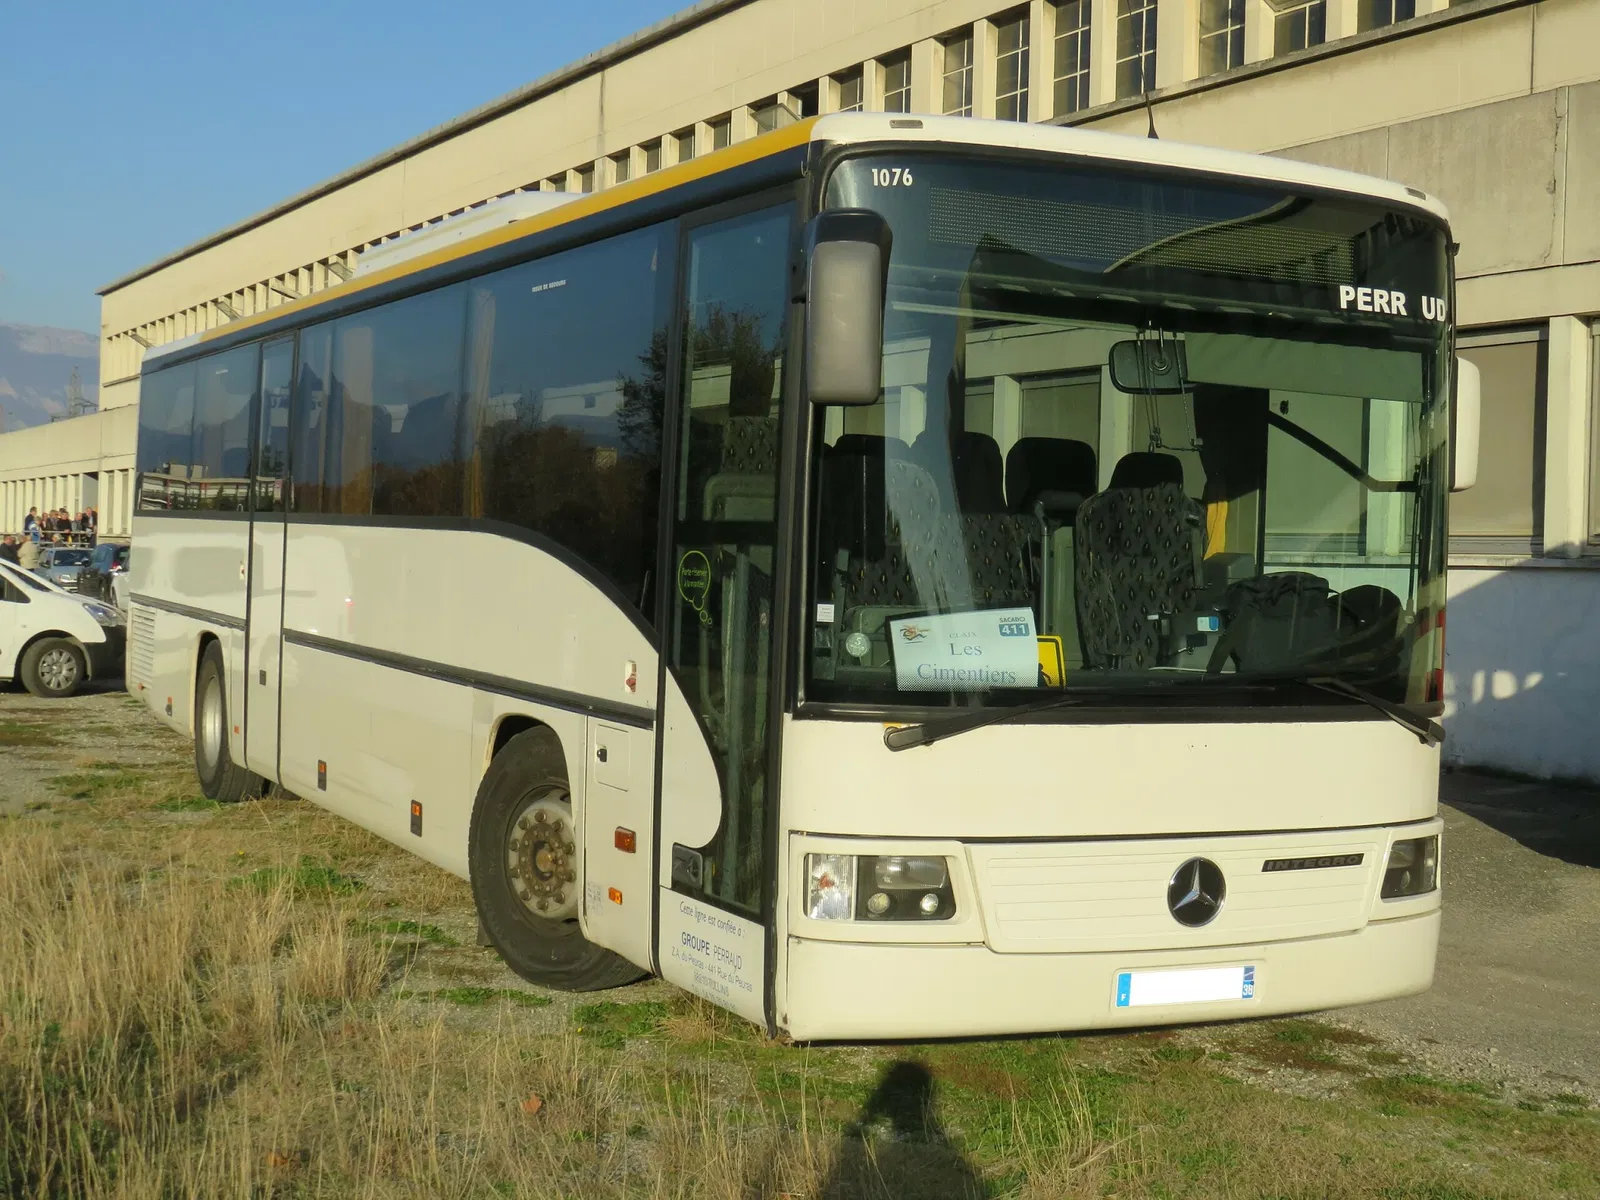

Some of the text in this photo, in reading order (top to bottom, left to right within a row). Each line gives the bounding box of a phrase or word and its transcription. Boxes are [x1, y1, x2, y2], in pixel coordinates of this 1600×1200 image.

[871, 168, 913, 187] 1076
[1001, 624, 1027, 635] 411
[949, 642, 983, 656] Les
[917, 663, 1017, 684] Cimentiers
[1267, 855, 1361, 870] INTEGRO
[708, 915, 716, 927] est
[681, 931, 743, 971] GROUPE PERRAUD
[1121, 993, 1127, 1001] F
[1242, 984, 1253, 996] 38
